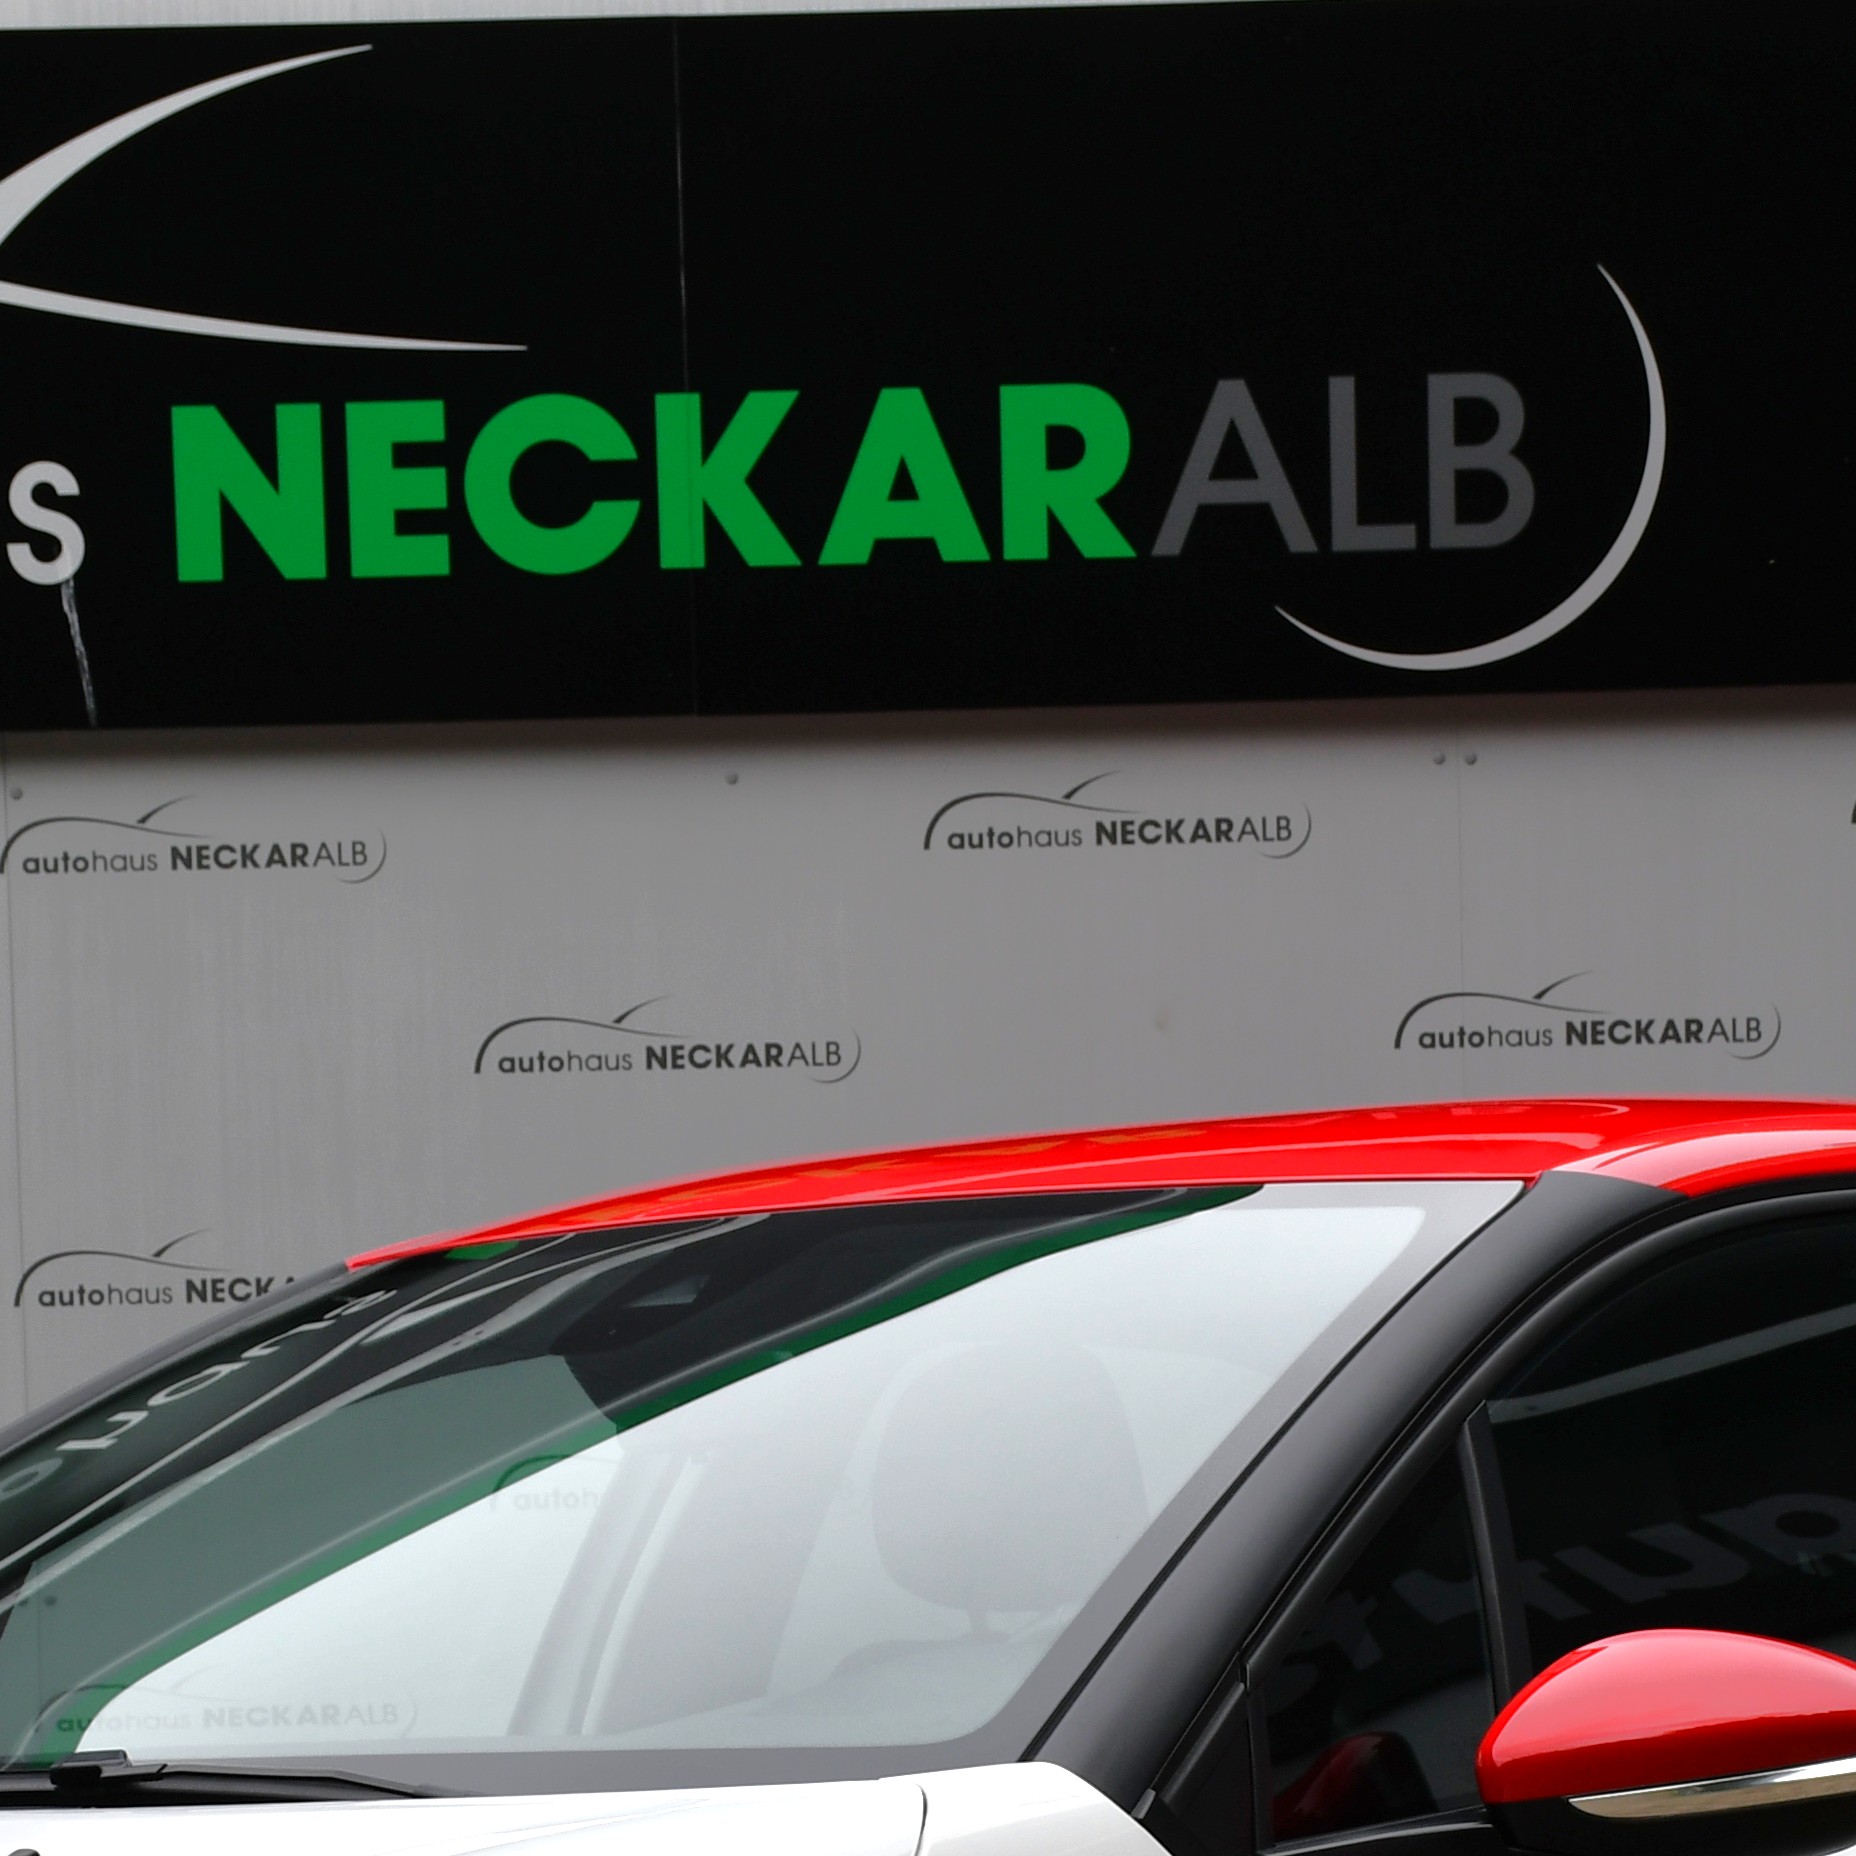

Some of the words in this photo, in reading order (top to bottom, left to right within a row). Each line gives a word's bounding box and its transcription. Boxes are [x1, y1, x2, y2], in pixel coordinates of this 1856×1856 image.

[171, 371, 1538, 582] NECKARALB
[947, 826, 1082, 850] autohaus
[1096, 816, 1292, 846] NECKARALB
[22, 851, 158, 874] autohaus
[171, 841, 367, 871] NECKARALB
[1418, 1026, 1553, 1049] autohaus
[1566, 1017, 1762, 1046] NECKARALB
[498, 1050, 632, 1073] autohaus
[646, 1041, 841, 1070] NECKARALB
[38, 1284, 172, 1307] autohaus
